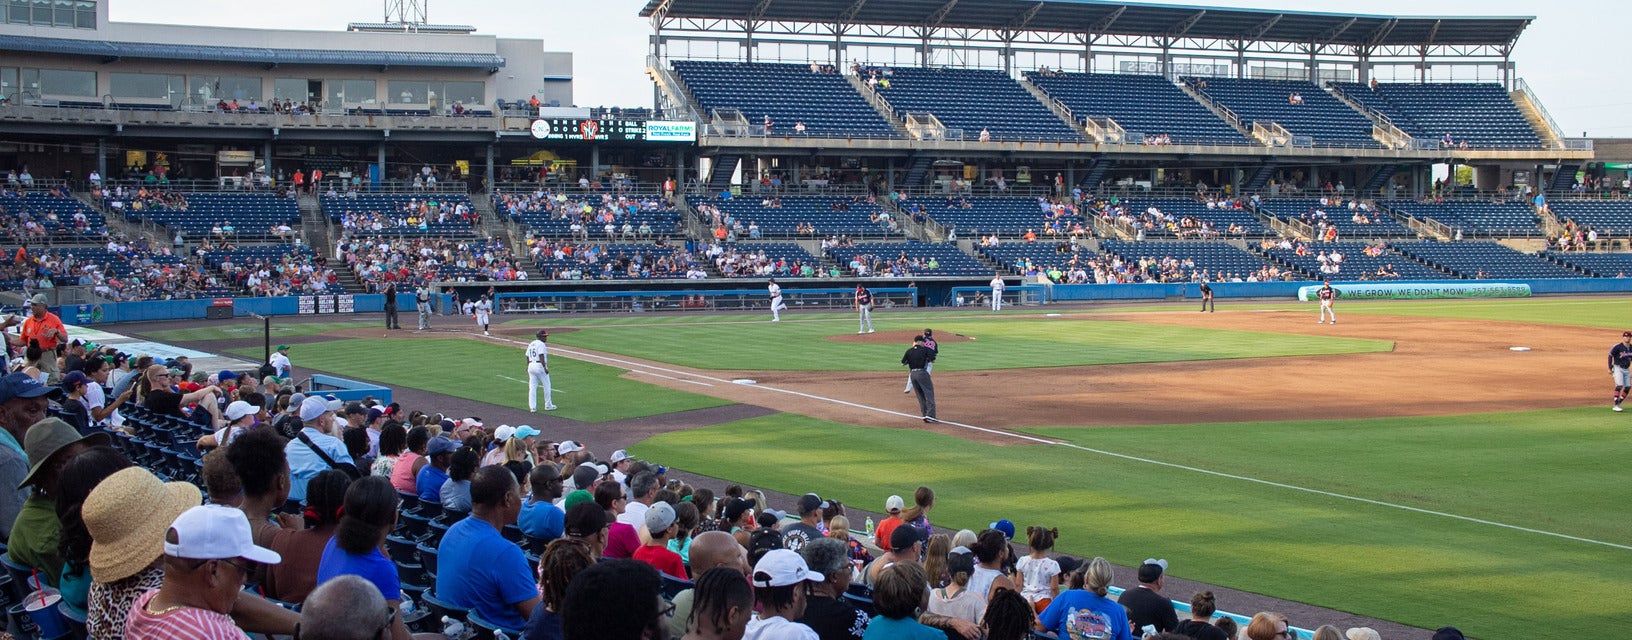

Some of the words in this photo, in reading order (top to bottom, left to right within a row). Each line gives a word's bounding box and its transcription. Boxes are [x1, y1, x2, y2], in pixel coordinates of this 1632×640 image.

[1348, 289, 1362, 297] WE
[1414, 288, 1441, 296] DON'T
[1443, 288, 1467, 296] MOW!
[530, 348, 536, 358] 16
